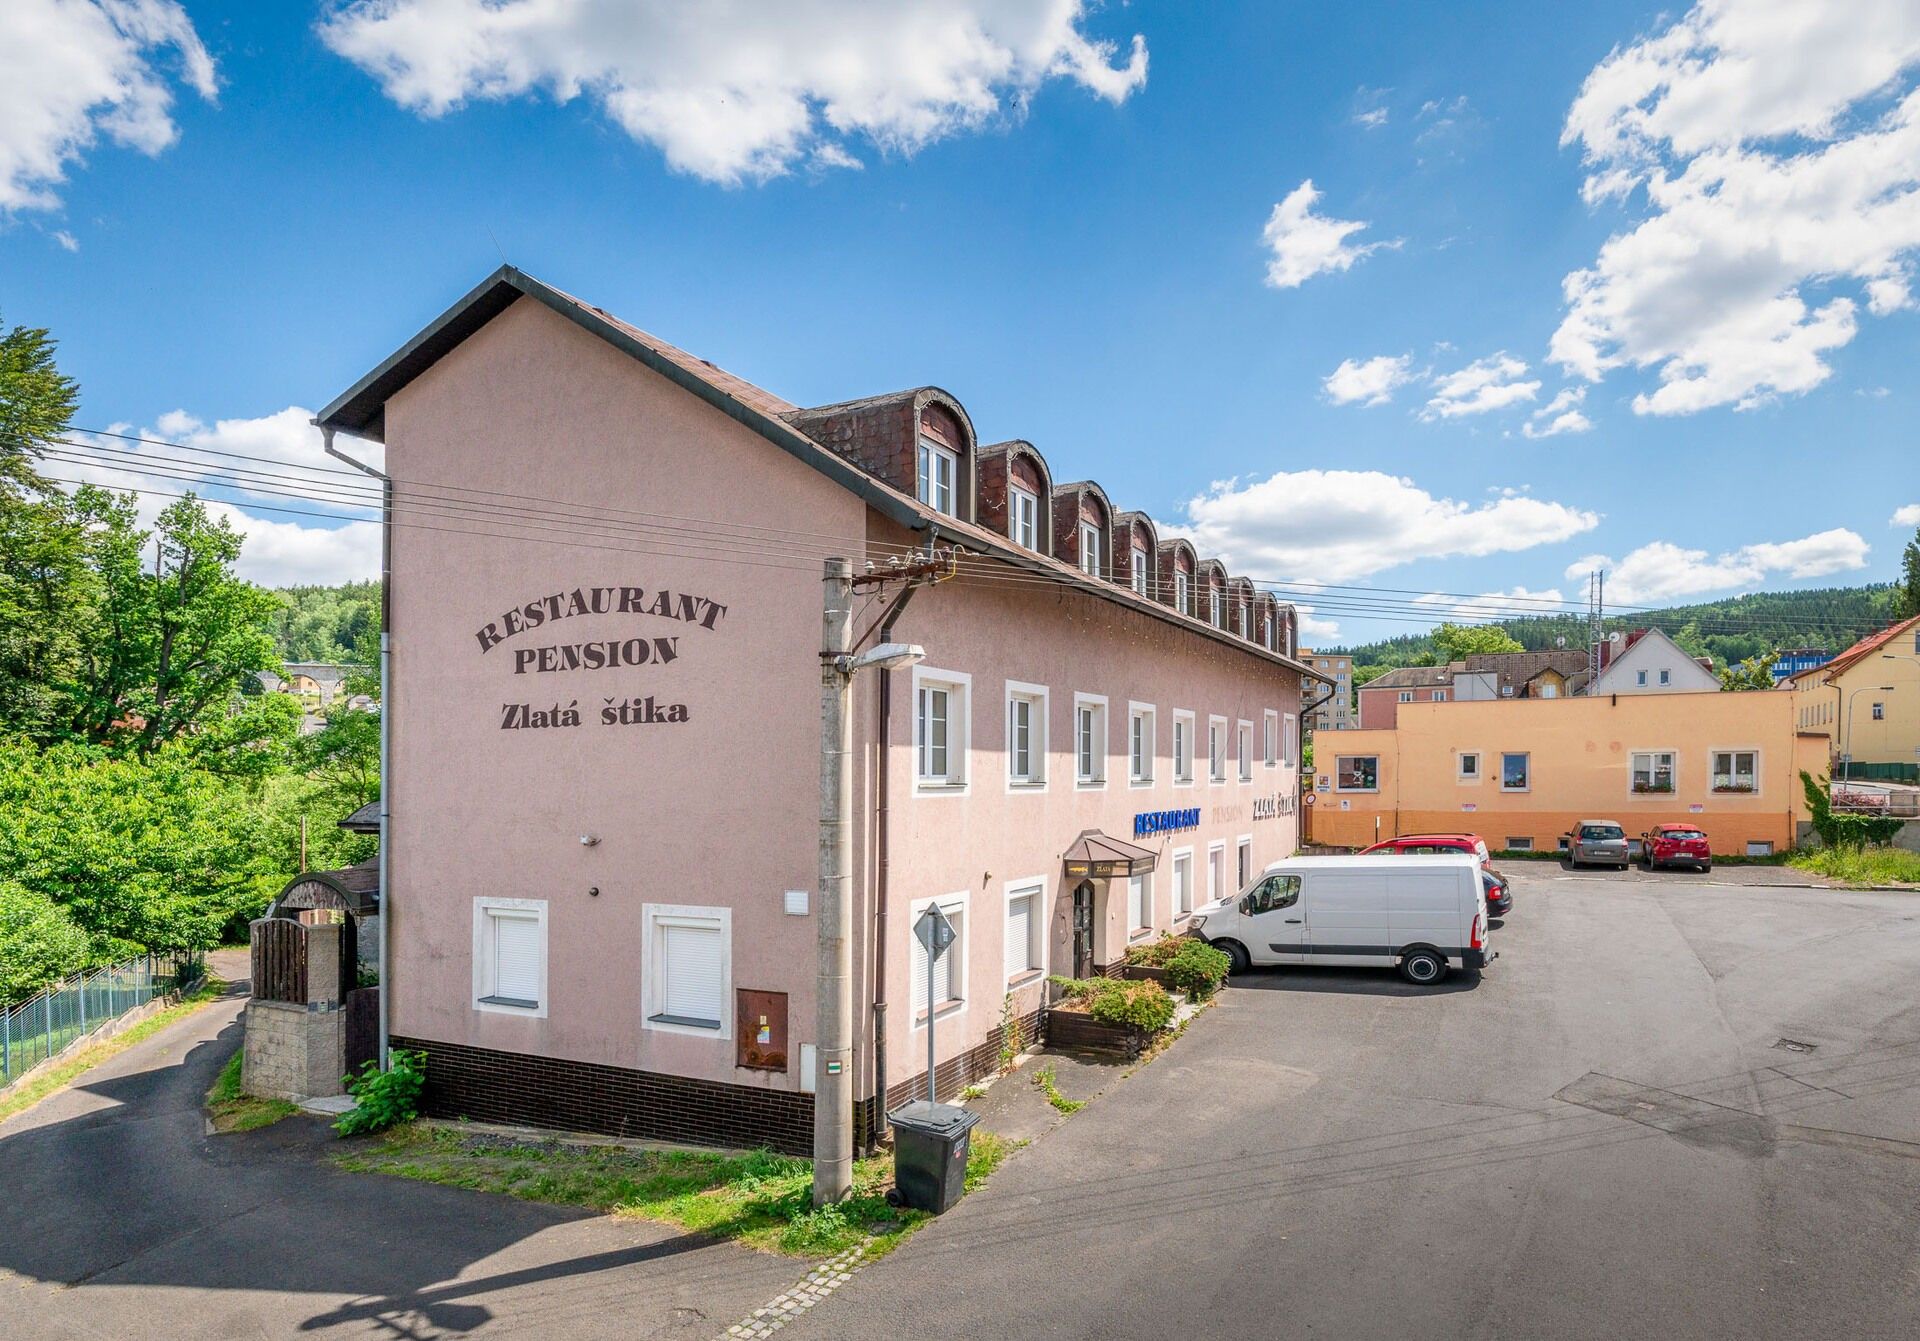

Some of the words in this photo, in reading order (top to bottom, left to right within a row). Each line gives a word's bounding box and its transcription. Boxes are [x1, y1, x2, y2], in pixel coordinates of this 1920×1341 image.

[474, 587, 728, 654] RESTAURANT
[514, 637, 680, 674] PENSION
[501, 700, 581, 730] Zlatá
[601, 696, 690, 725] štika
[1134, 807, 1201, 835] RESTAURANT
